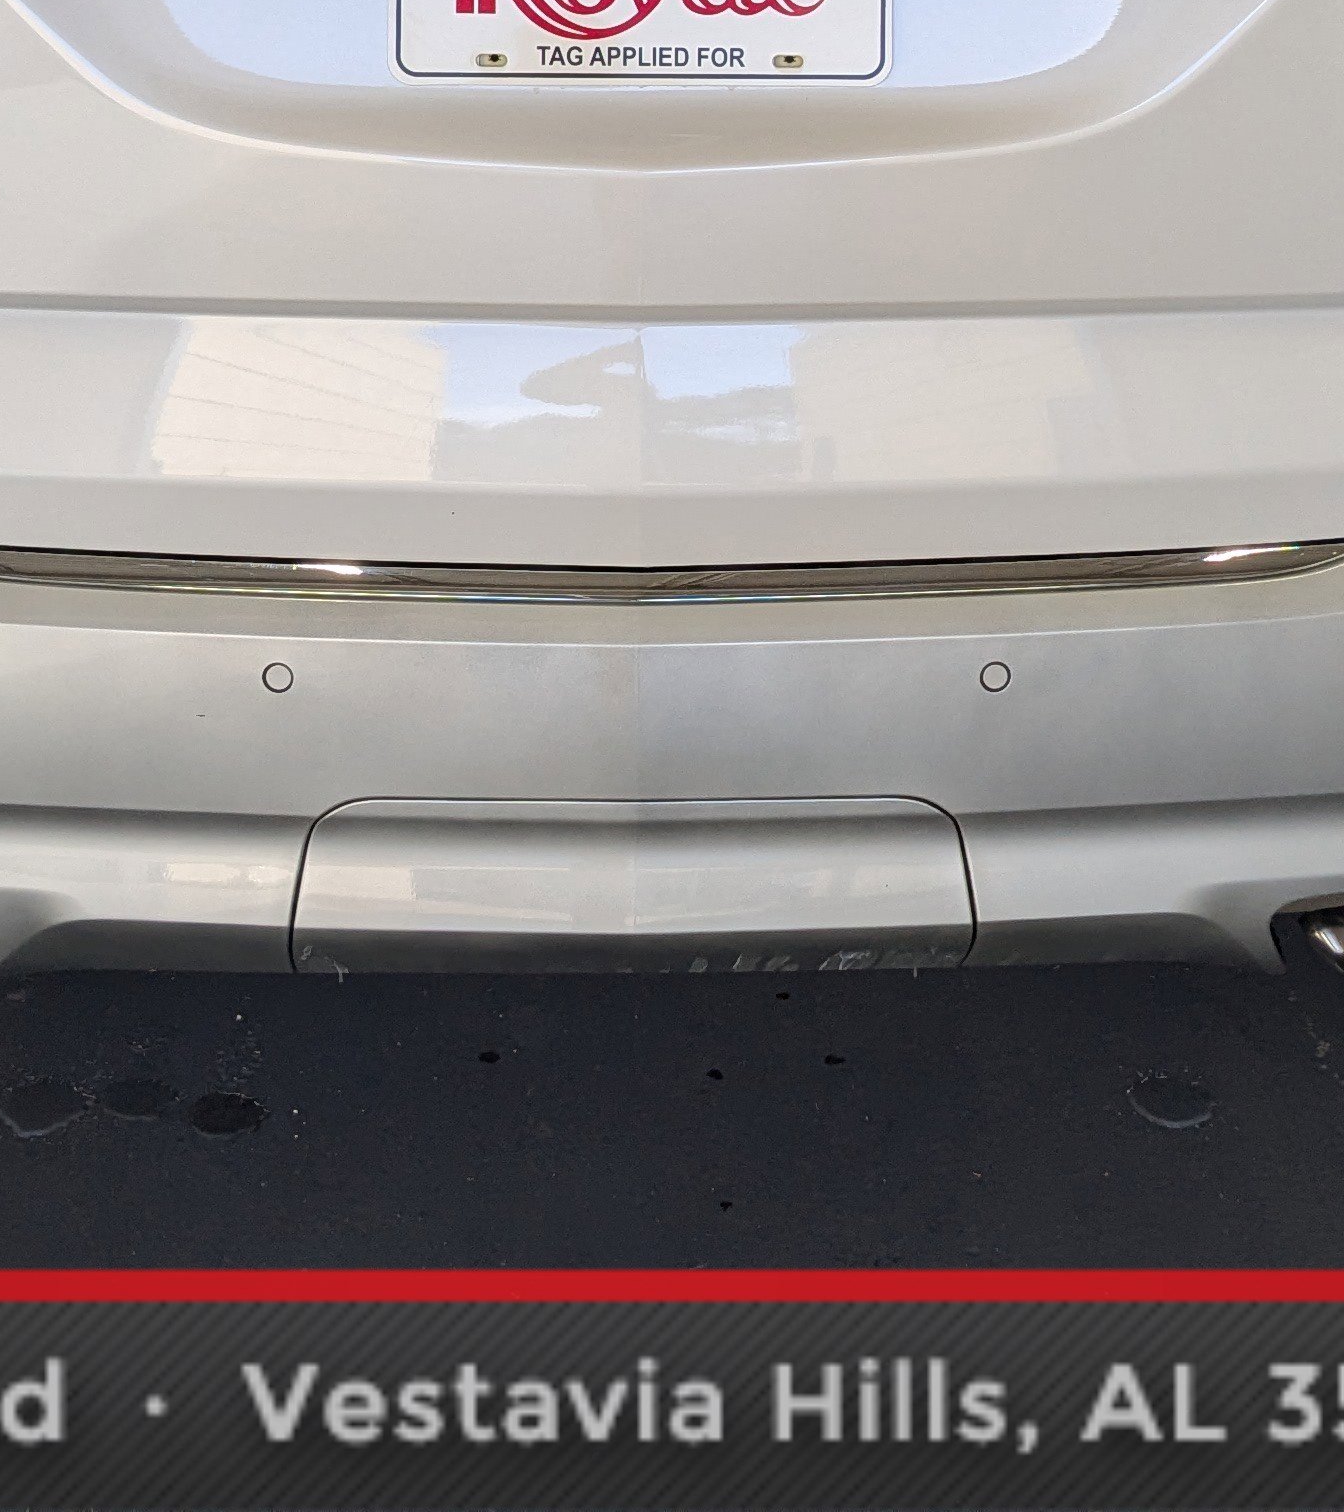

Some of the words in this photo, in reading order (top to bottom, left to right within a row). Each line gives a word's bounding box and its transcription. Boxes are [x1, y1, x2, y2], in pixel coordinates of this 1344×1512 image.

[536, 45, 583, 67] TAG
[589, 46, 689, 67] APPLIED
[697, 47, 745, 68] FOR
